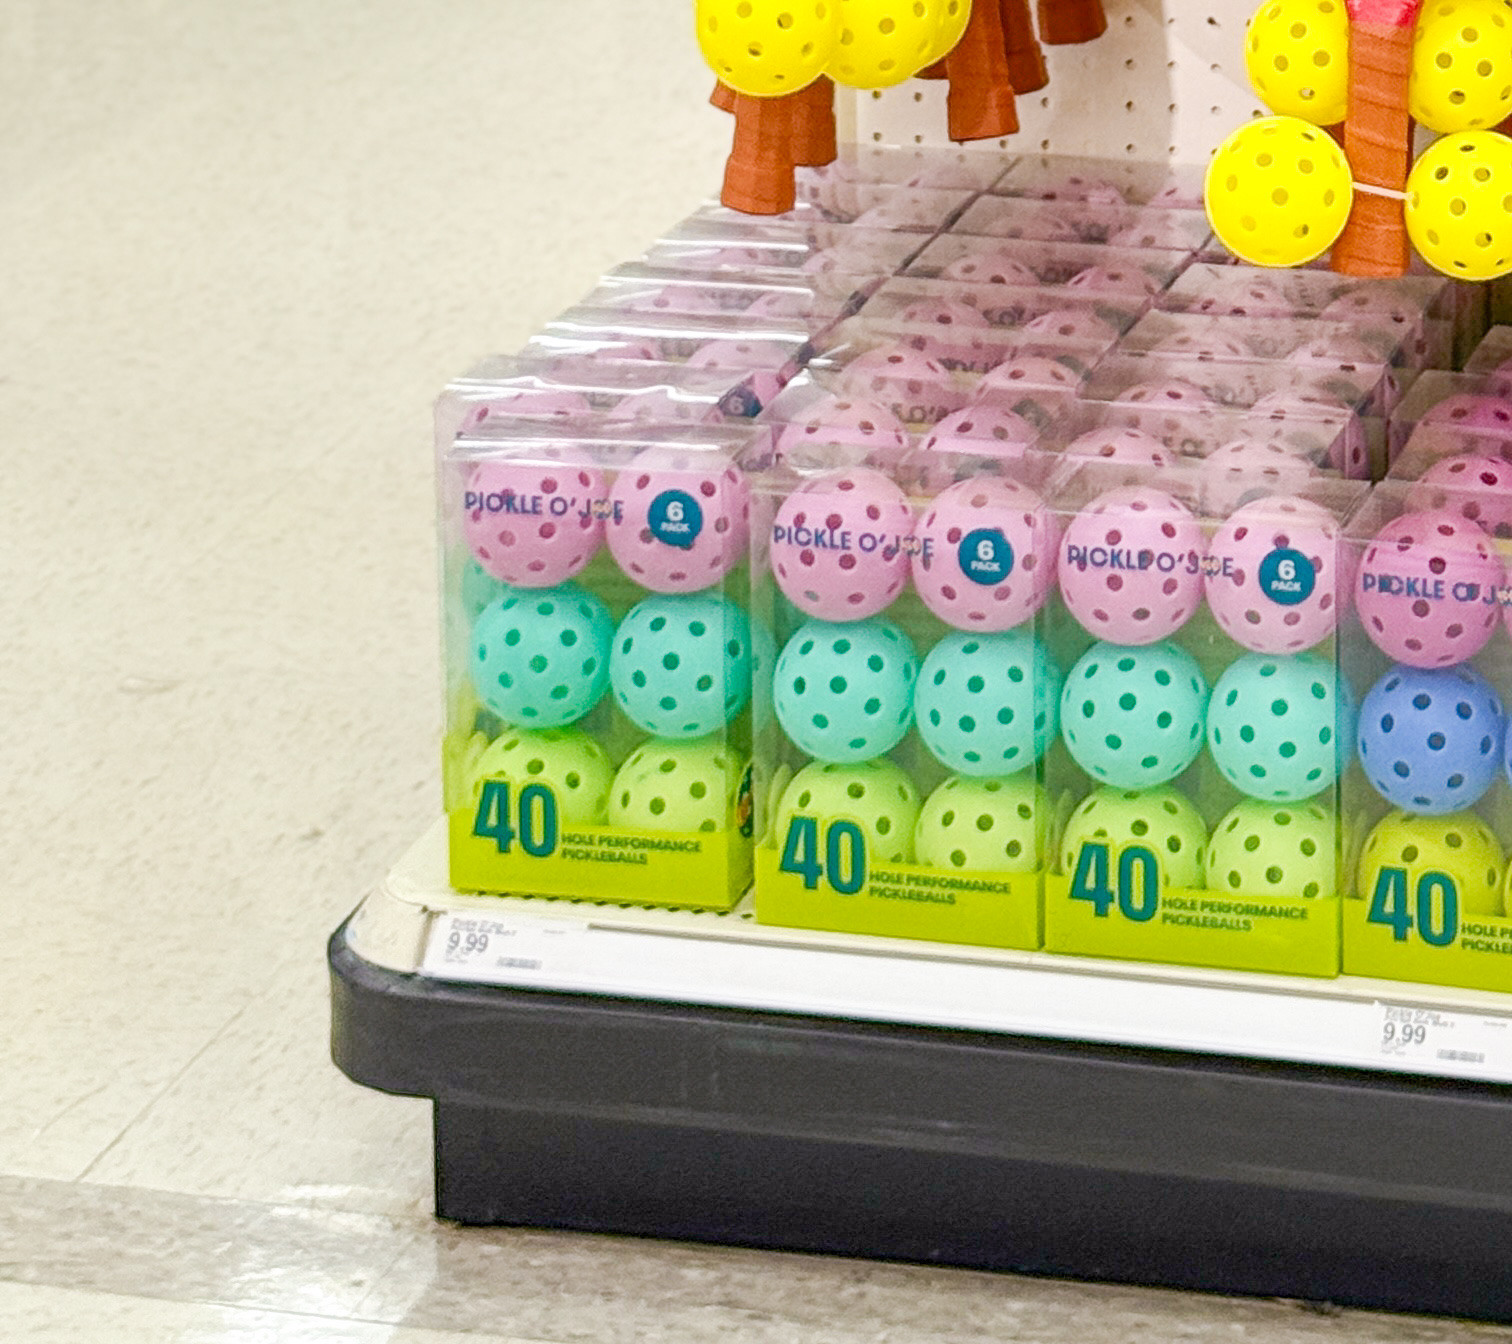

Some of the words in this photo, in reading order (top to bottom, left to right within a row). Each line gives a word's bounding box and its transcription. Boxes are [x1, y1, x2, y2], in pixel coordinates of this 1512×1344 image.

[465, 491, 543, 515] PICKLE
[665, 501, 685, 522] 6
[774, 525, 852, 550] PICKLE
[976, 540, 995, 561] 6
[970, 561, 1001, 572] PACK
[1278, 559, 1297, 580] 6
[1271, 581, 1301, 593] PACK
[474, 780, 558, 858] 40
[561, 832, 596, 847] HOLE
[599, 834, 703, 853] PERFORMANCE
[561, 849, 648, 865] PICKLEBALLS
[779, 815, 866, 895] 40
[869, 870, 904, 884] HOLE
[906, 872, 1012, 894] PERFORMANCE
[1069, 841, 1159, 923] 40
[869, 886, 956, 905] PICKLEBALLS
[1162, 897, 1198, 911] HOLE
[1200, 899, 1309, 920] PERFORMANCE
[1366, 865, 1458, 948] 40
[1162, 913, 1252, 932] PICKLEBALLS
[1461, 923, 1497, 938] HOLE
[447, 932, 489, 953] 9.99
[1383, 1022, 1427, 1045] 9.99
